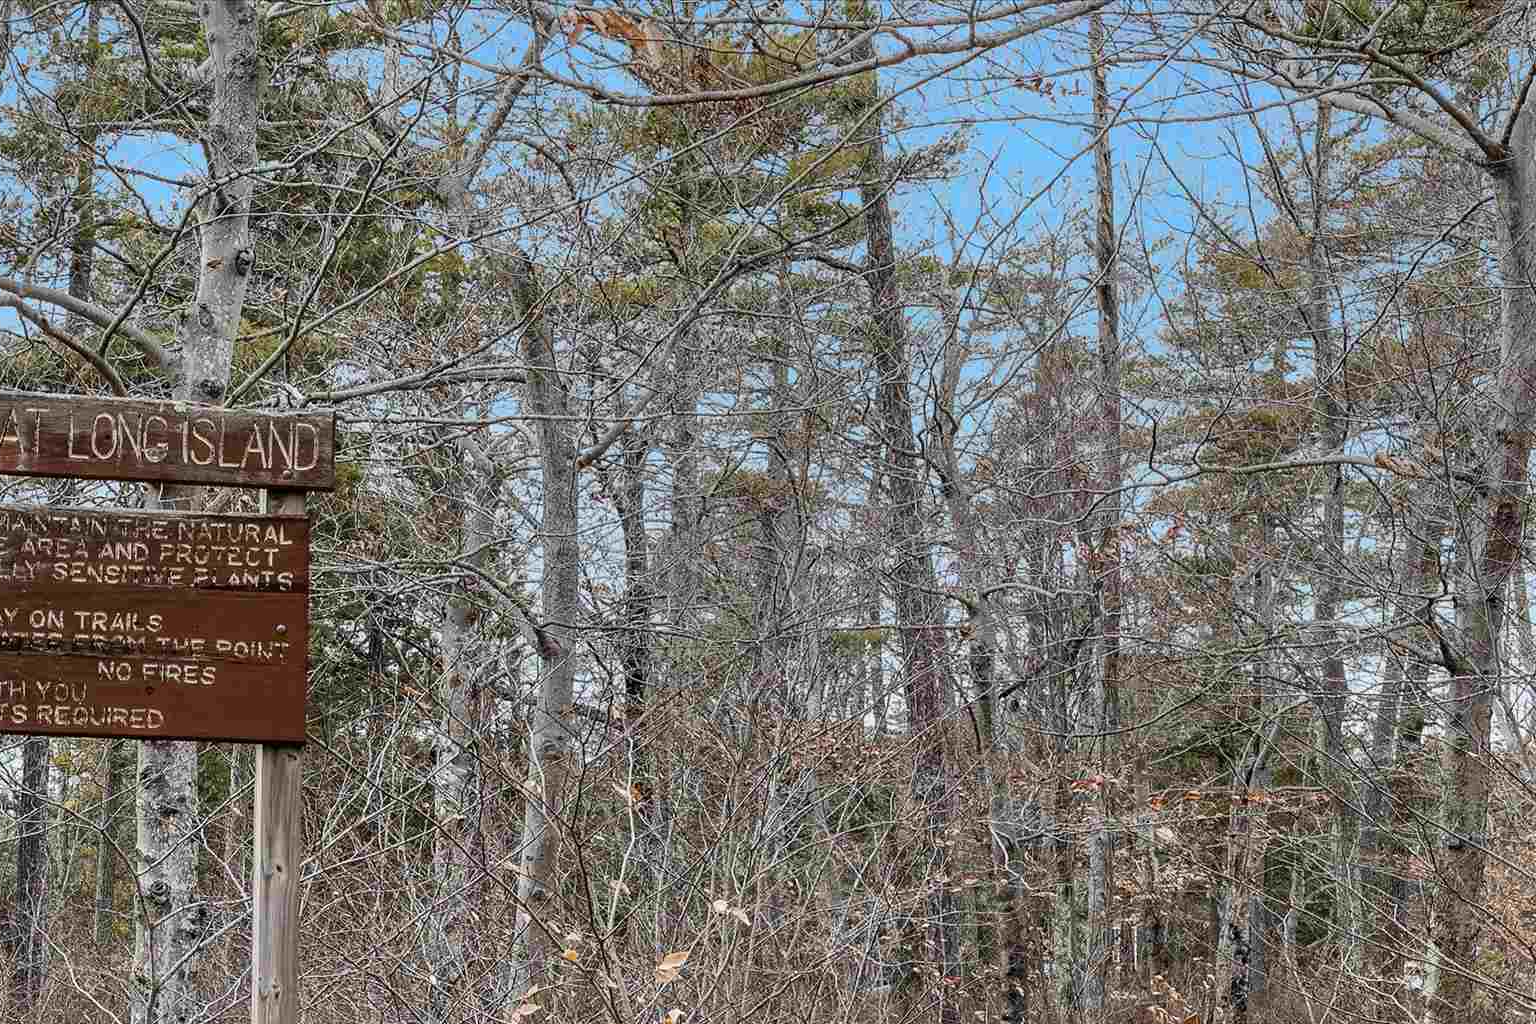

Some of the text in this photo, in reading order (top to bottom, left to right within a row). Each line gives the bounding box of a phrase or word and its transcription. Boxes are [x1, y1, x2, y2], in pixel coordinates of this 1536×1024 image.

[68, 412, 168, 462] LONG
[180, 416, 319, 470] ISLAND
[178, 521, 293, 545] NATURAL
[19, 537, 89, 560] AREA
[98, 542, 149, 562] AND
[160, 544, 280, 567] PROTECT
[29, 609, 64, 629] ON
[74, 611, 163, 633] TRAILS
[216, 640, 290, 664] POINT
[97, 660, 217, 685] NO FIRES
[36, 680, 88, 703] YOU
[36, 703, 164, 729] REQUIRED
